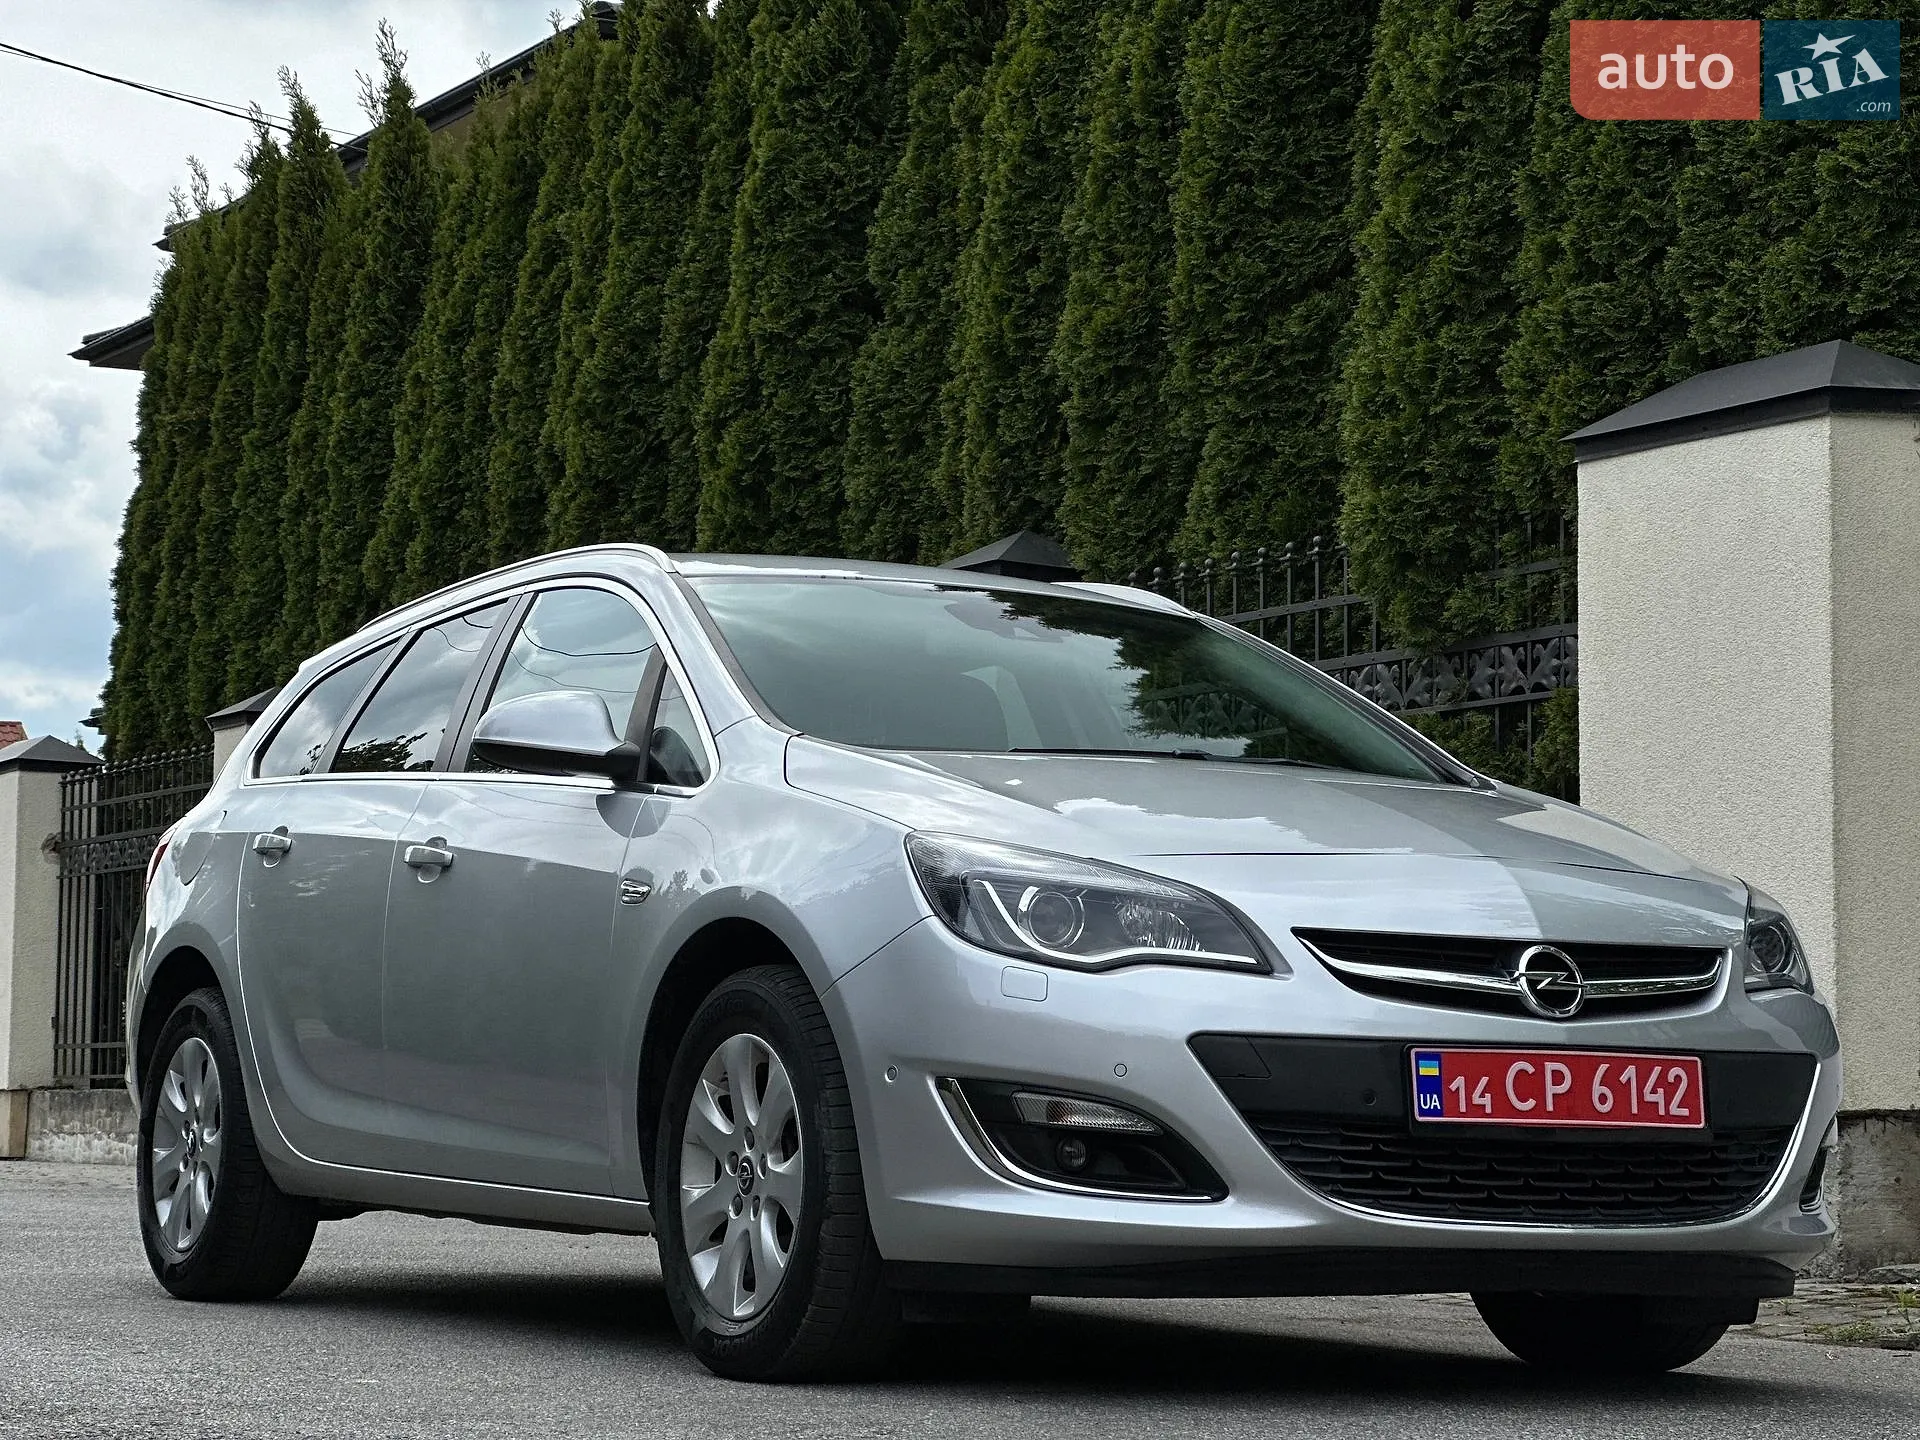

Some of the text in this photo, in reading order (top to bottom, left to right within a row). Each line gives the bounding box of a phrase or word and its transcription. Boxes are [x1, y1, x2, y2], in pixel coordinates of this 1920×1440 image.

[1420, 1093, 1441, 1109] UA
[1448, 1061, 1689, 1116] 14 CP 6142
